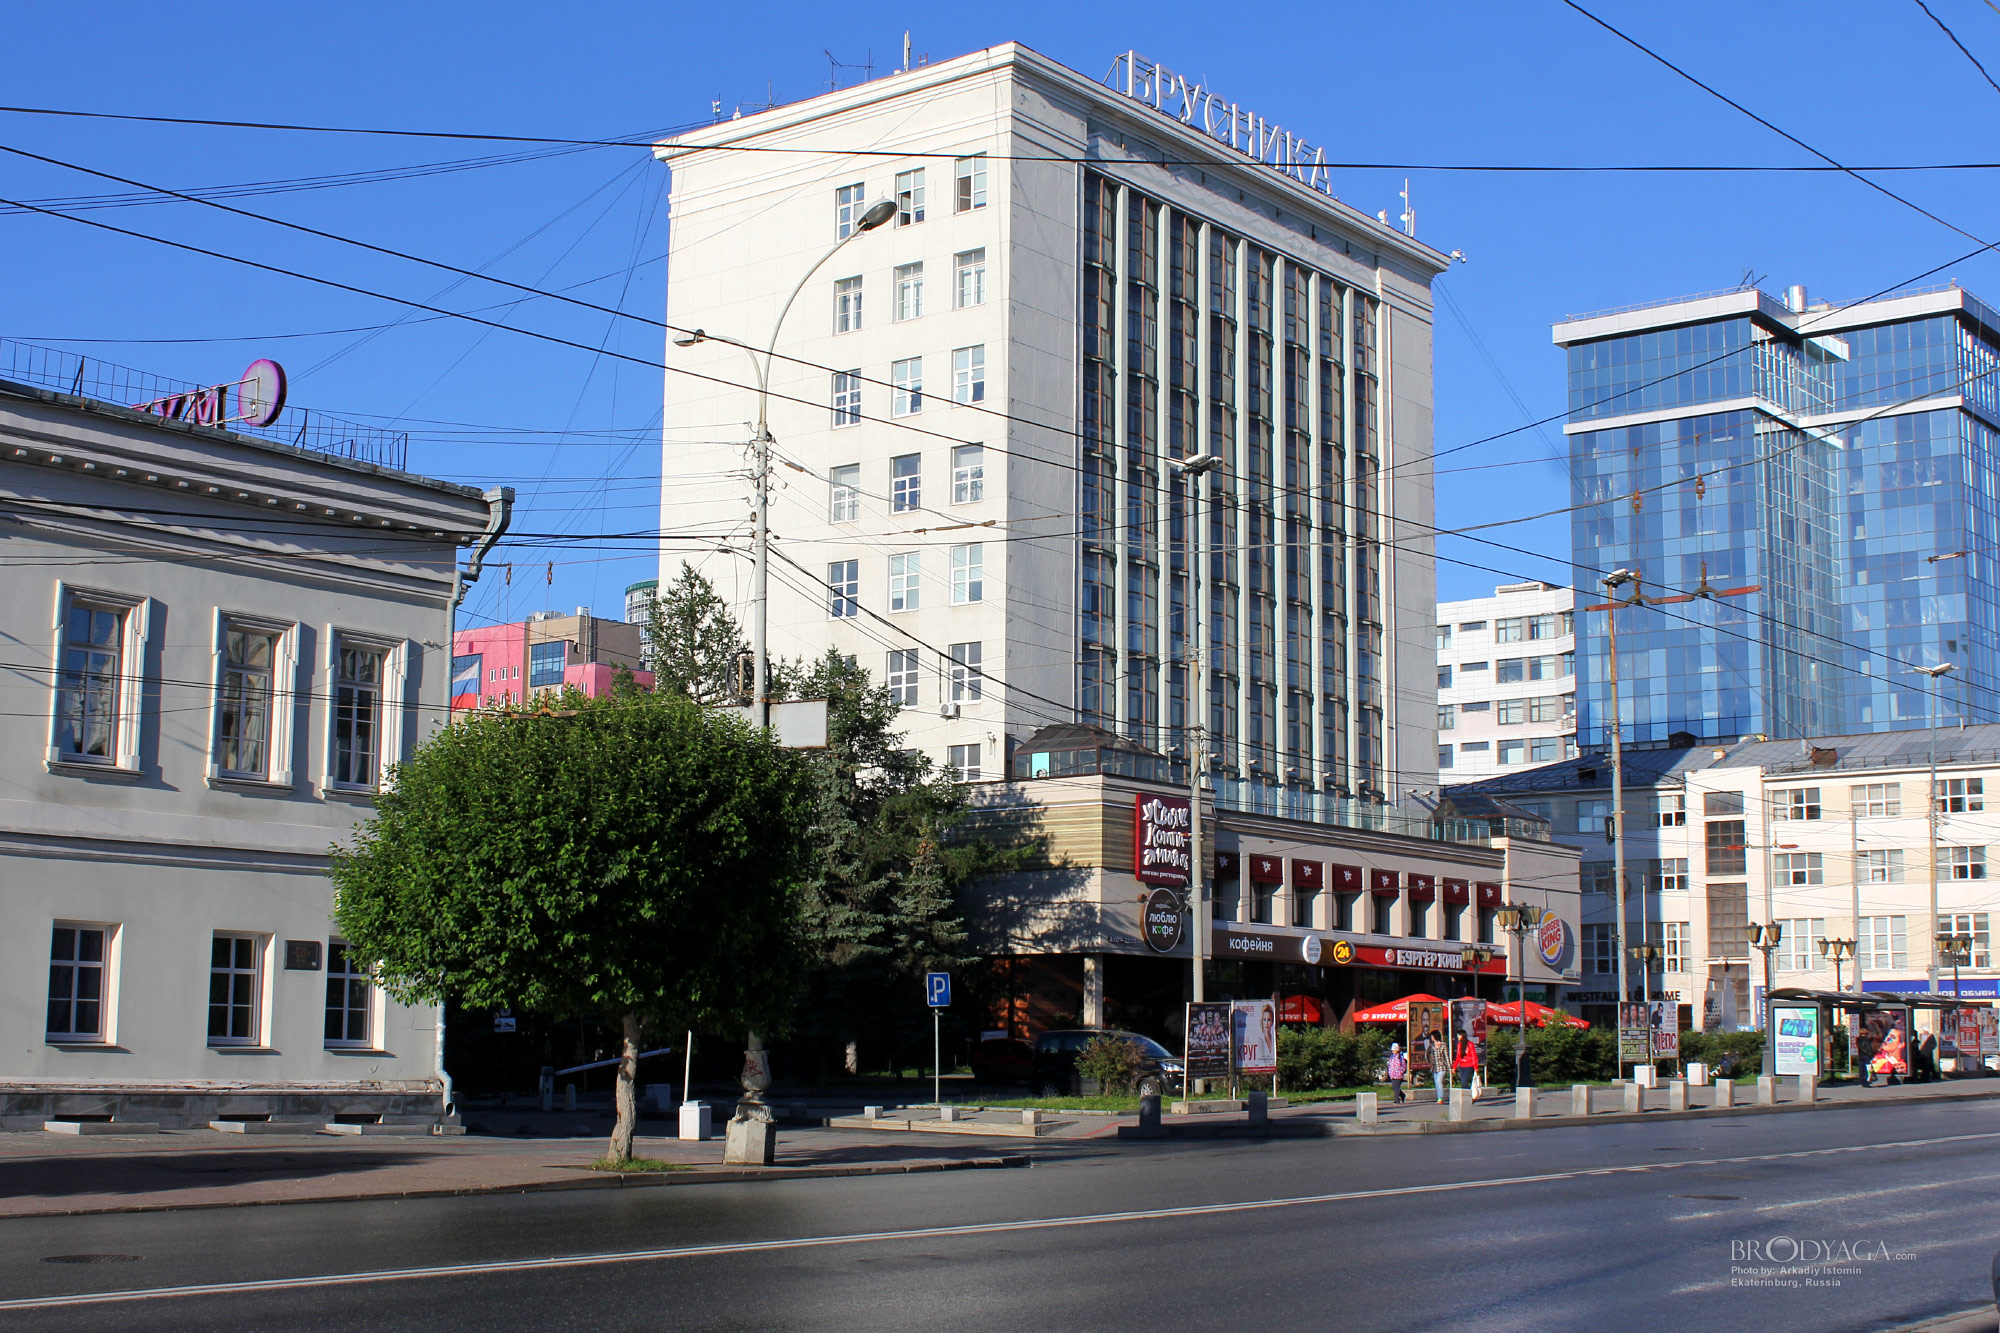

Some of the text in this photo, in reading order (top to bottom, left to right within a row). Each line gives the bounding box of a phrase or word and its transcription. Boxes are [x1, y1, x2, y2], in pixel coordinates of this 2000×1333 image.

[1128, 49, 1332, 195] БРУСНИКА
[1149, 911, 1177, 924] люблю
[1541, 919, 1560, 938] BURGER
[1229, 937, 1273, 953] кофейня
[1541, 928, 1561, 952] KING
[1337, 946, 1350, 958] 24
[1397, 949, 1437, 967] БУРГЕР
[934, 976, 946, 1002] P
[1237, 1044, 1258, 1061] КРУГ
